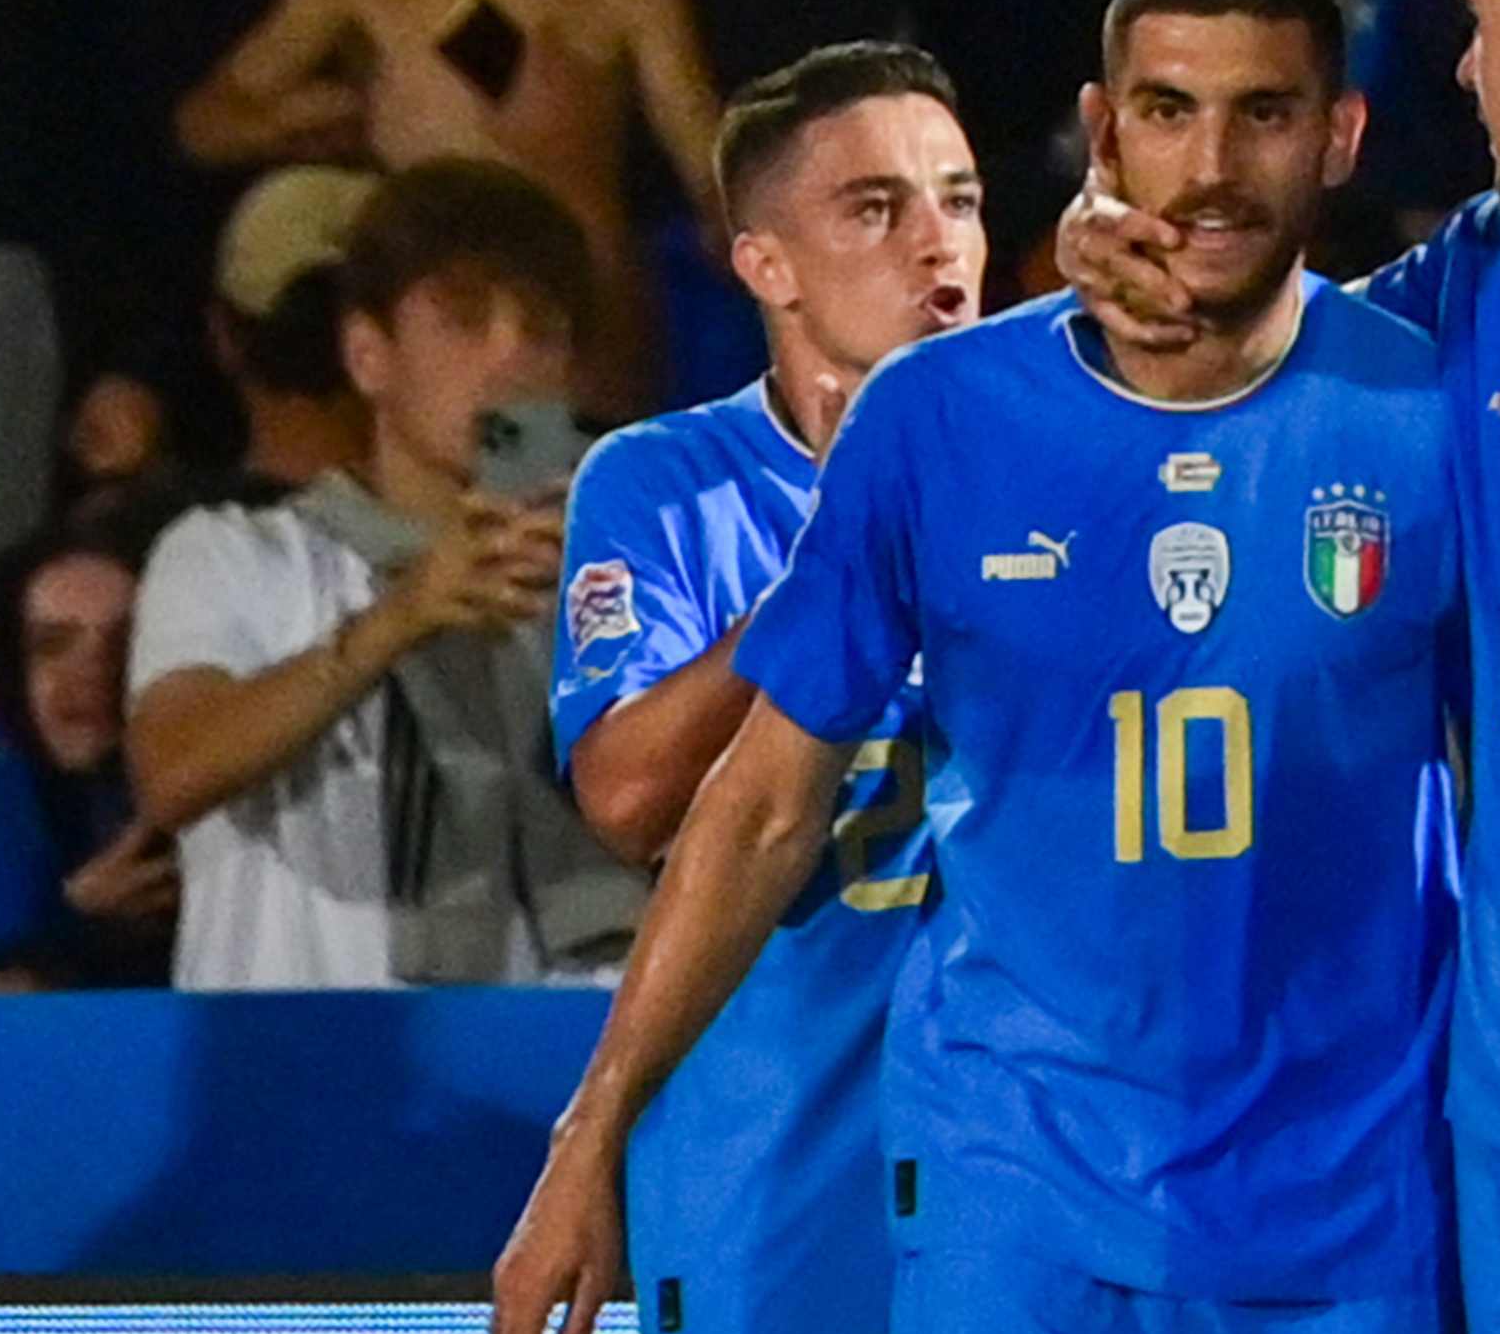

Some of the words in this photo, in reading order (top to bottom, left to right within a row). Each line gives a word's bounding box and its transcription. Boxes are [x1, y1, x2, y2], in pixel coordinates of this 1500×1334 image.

[1311, 510, 1381, 532] ITALIA
[833, 739, 932, 912] 2
[1108, 686, 1254, 863] 10
